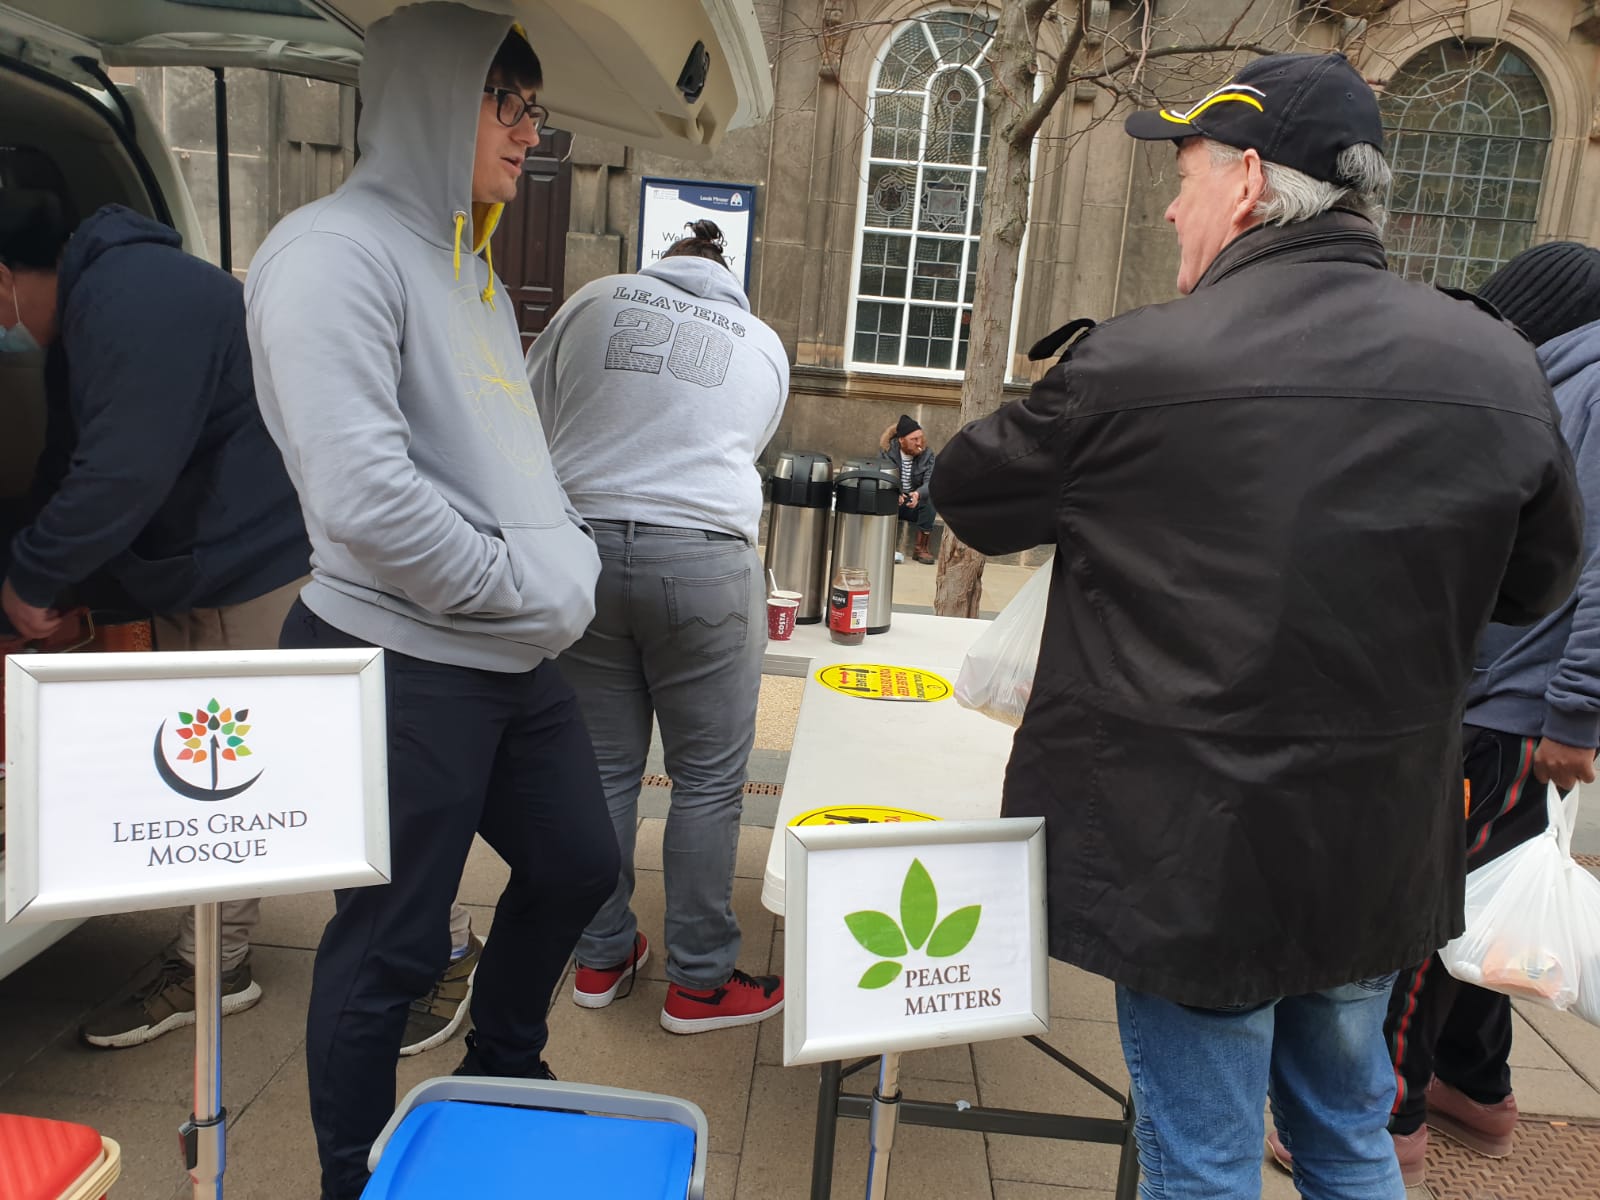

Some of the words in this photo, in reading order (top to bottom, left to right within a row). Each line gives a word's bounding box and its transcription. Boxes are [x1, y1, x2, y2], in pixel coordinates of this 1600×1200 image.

[612, 286, 746, 338] LEAVERS
[604, 307, 734, 389] 20
[778, 612, 786, 635] COSTA
[113, 818, 199, 843] LEEDS
[207, 810, 308, 834] GRAND
[147, 838, 268, 867] MOSQUE
[904, 964, 971, 988] PEACE
[904, 987, 1002, 1016] MATTERS
